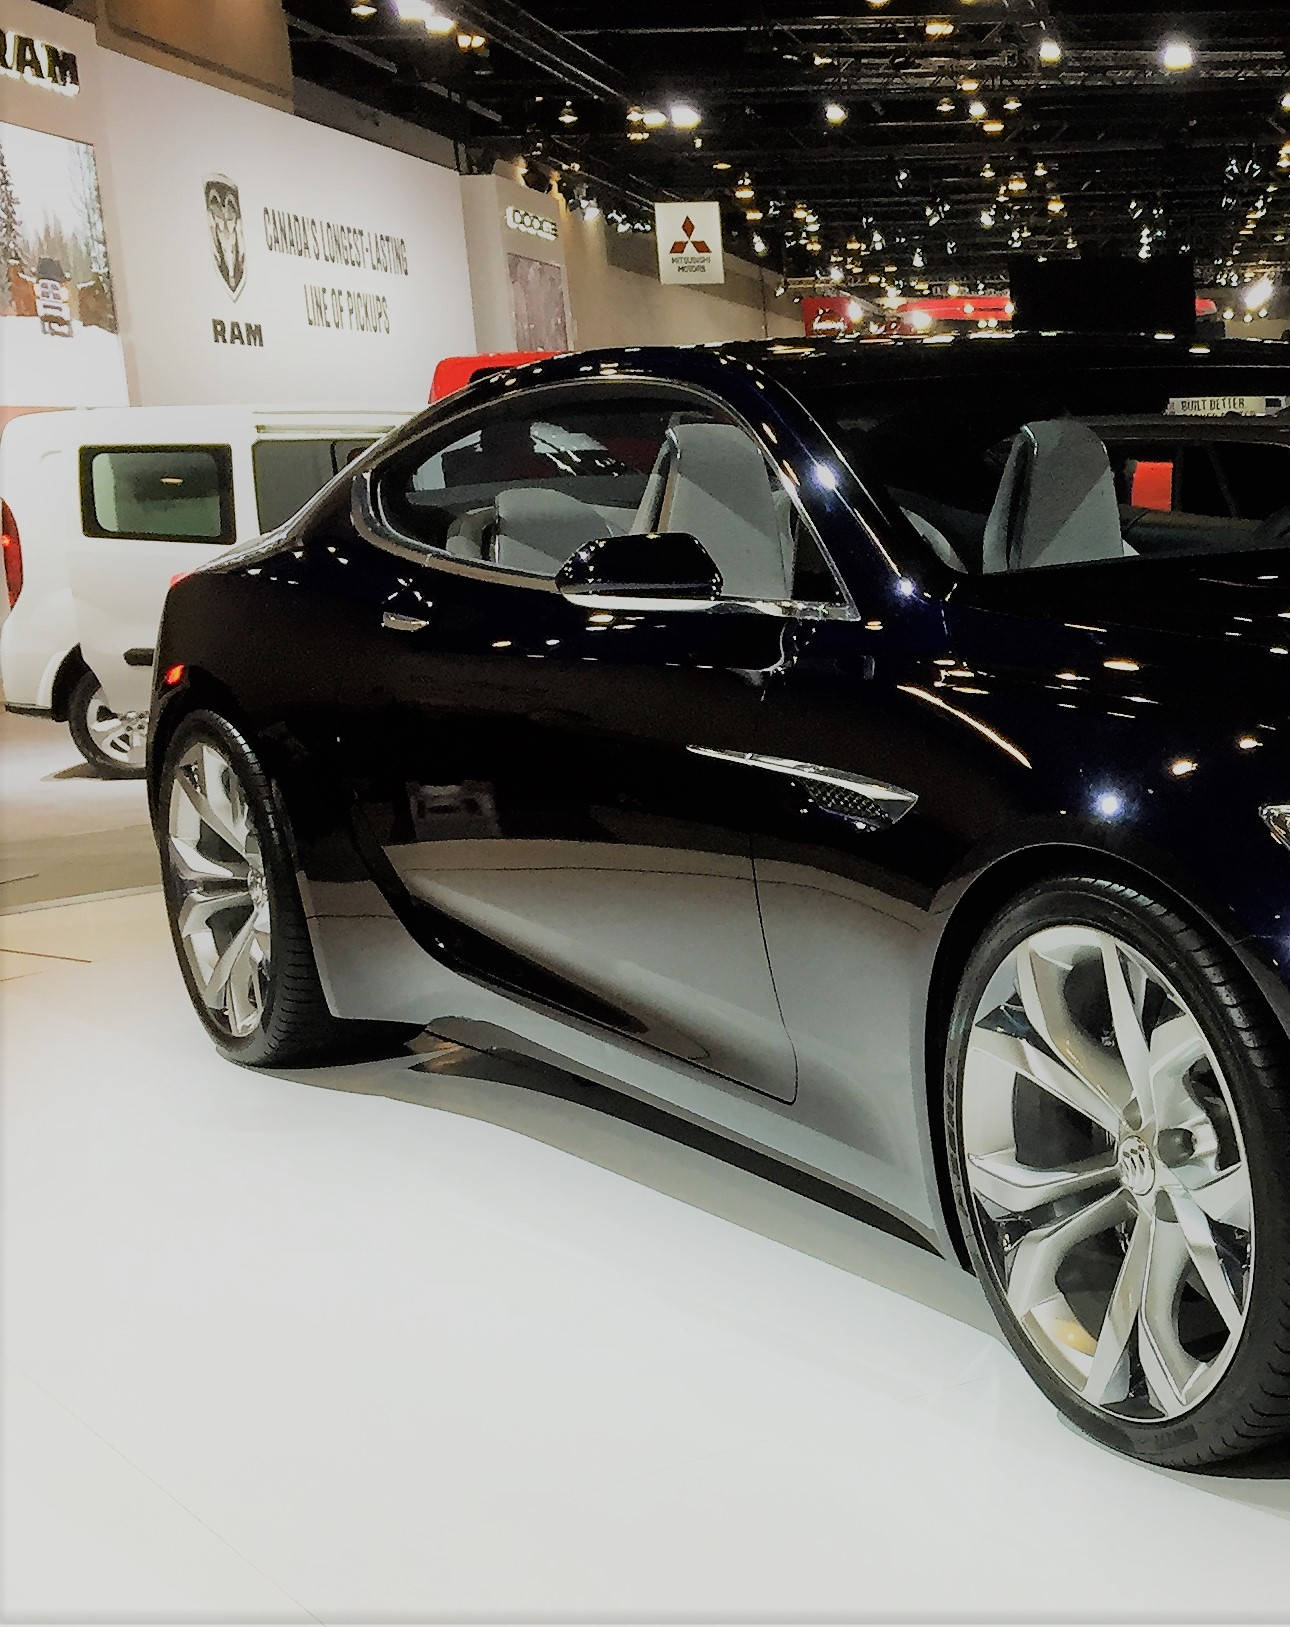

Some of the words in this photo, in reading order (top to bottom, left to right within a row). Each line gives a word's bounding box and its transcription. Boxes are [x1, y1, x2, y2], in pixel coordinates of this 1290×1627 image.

[262, 206, 320, 261] CANADA'S
[320, 220, 409, 276] LONGEST-LASTING
[211, 317, 265, 348] RAM
[303, 283, 331, 328] LINE
[331, 287, 344, 330] OF
[346, 289, 391, 335] PICKUPS
